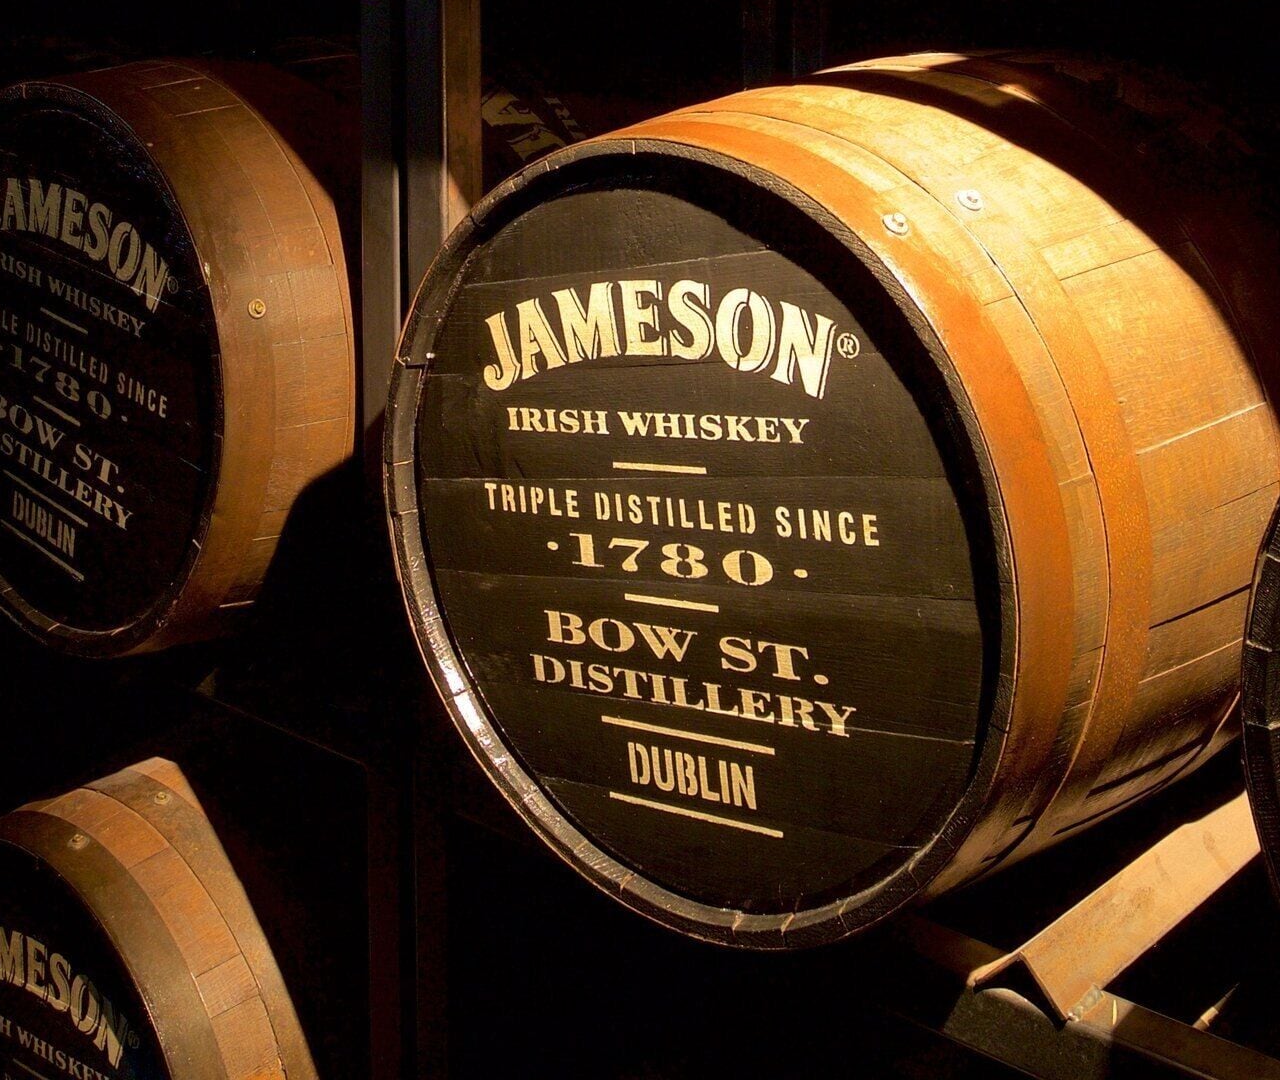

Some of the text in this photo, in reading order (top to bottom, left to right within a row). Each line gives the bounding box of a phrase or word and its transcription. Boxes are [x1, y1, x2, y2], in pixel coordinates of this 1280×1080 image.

[47, 273, 147, 340] WHISKEY
[25, 318, 109, 384] DISTILLED
[116, 367, 169, 420] SINCE
[506, 406, 810, 444] IRISH WHISKEY
[72, 440, 125, 495] ST.
[10, 487, 76, 560] DUBLIN
[484, 482, 881, 548] TRIPLE DISTILLED SINCE
[543, 610, 830, 686] BOW ST.
[529, 653, 857, 738] DISTILLERY
[627, 742, 758, 812] DUBLIN
